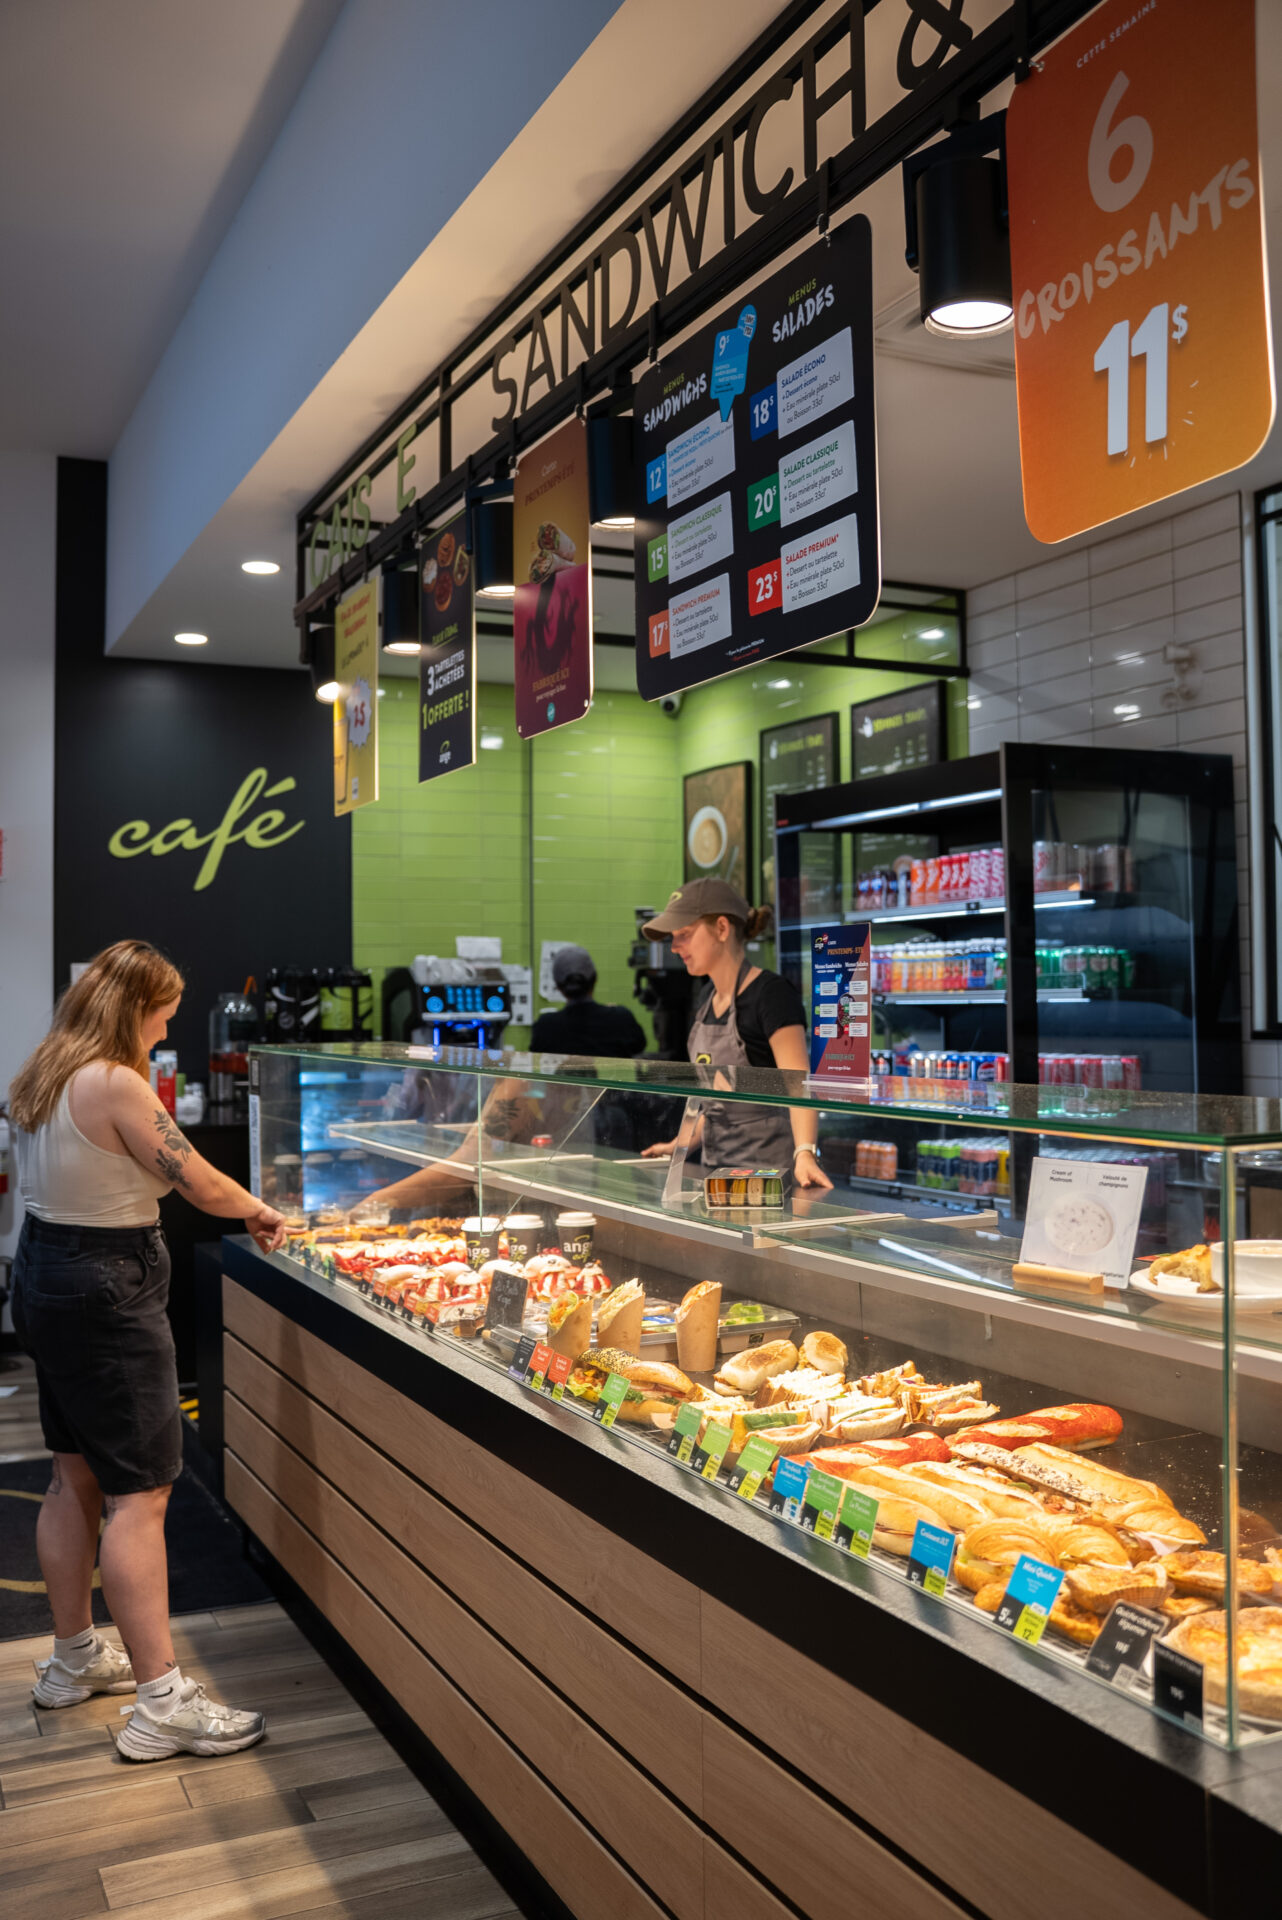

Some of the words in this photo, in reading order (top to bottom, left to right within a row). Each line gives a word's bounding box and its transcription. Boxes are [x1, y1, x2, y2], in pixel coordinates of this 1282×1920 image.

[1076, 40, 1106, 69] CETTE
[1109, 0, 1157, 42] SEMAINE
[1088, 70, 1153, 212] 6
[491, 2, 866, 433] SANDWICH
[1017, 158, 1256, 340] CROISSANTS
[788, 278, 817, 306] MENUS
[772, 284, 835, 343] SALADES
[663, 373, 685, 395] MENUS
[781, 368, 803, 388] SALADE
[804, 354, 826, 375] ÉCONO
[643, 373, 707, 433] SANDWICHS
[785, 384, 803, 399] Dessert
[786, 401, 795, 412] Eau
[795, 388, 815, 406] minérale
[816, 382, 828, 397] plate
[828, 372, 841, 386] 50cl
[787, 416, 793, 424] ou
[793, 405, 811, 420] Boisson
[668, 435, 692, 459] SANDWICH
[783, 459, 805, 477] SALADE
[805, 440, 839, 465] CLASSIQUE
[787, 475, 806, 489] Dessert
[812, 459, 835, 477] tartelette
[788, 491, 797, 501] Eau
[797, 479, 818, 496] minérale
[818, 474, 831, 488] plate
[831, 466, 843, 479] 50cl
[789, 506, 795, 514] ou
[796, 496, 814, 510] Boisson
[671, 519, 695, 539] SANDWICH
[696, 503, 723, 525] CLASSIQUE
[785, 547, 808, 565] SALADE
[790, 563, 807, 576] Dessert
[815, 550, 838, 569] tartelette
[790, 579, 799, 590] Eau
[799, 569, 820, 586] minérale
[820, 566, 832, 582] plate
[833, 559, 845, 572] 50cl
[672, 598, 697, 617] SANDWICH
[791, 594, 798, 602] ou
[798, 585, 816, 600] Boisson
[427, 666, 434, 696] 3
[435, 649, 465, 673] TARTELETTES
[435, 665, 465, 692] ACHETÉES
[422, 703, 428, 730] 1
[428, 692, 464, 726] OFFERTE
[108, 768, 305, 891] café
[1049, 1176, 1073, 1184] Mushroom
[1051, 1169, 1066, 1177] Cream
[1098, 1181, 1129, 1189] champignons
[465, 1244, 490, 1260] nge
[563, 1239, 593, 1258] ang
[1022, 1561, 1036, 1573] Mini
